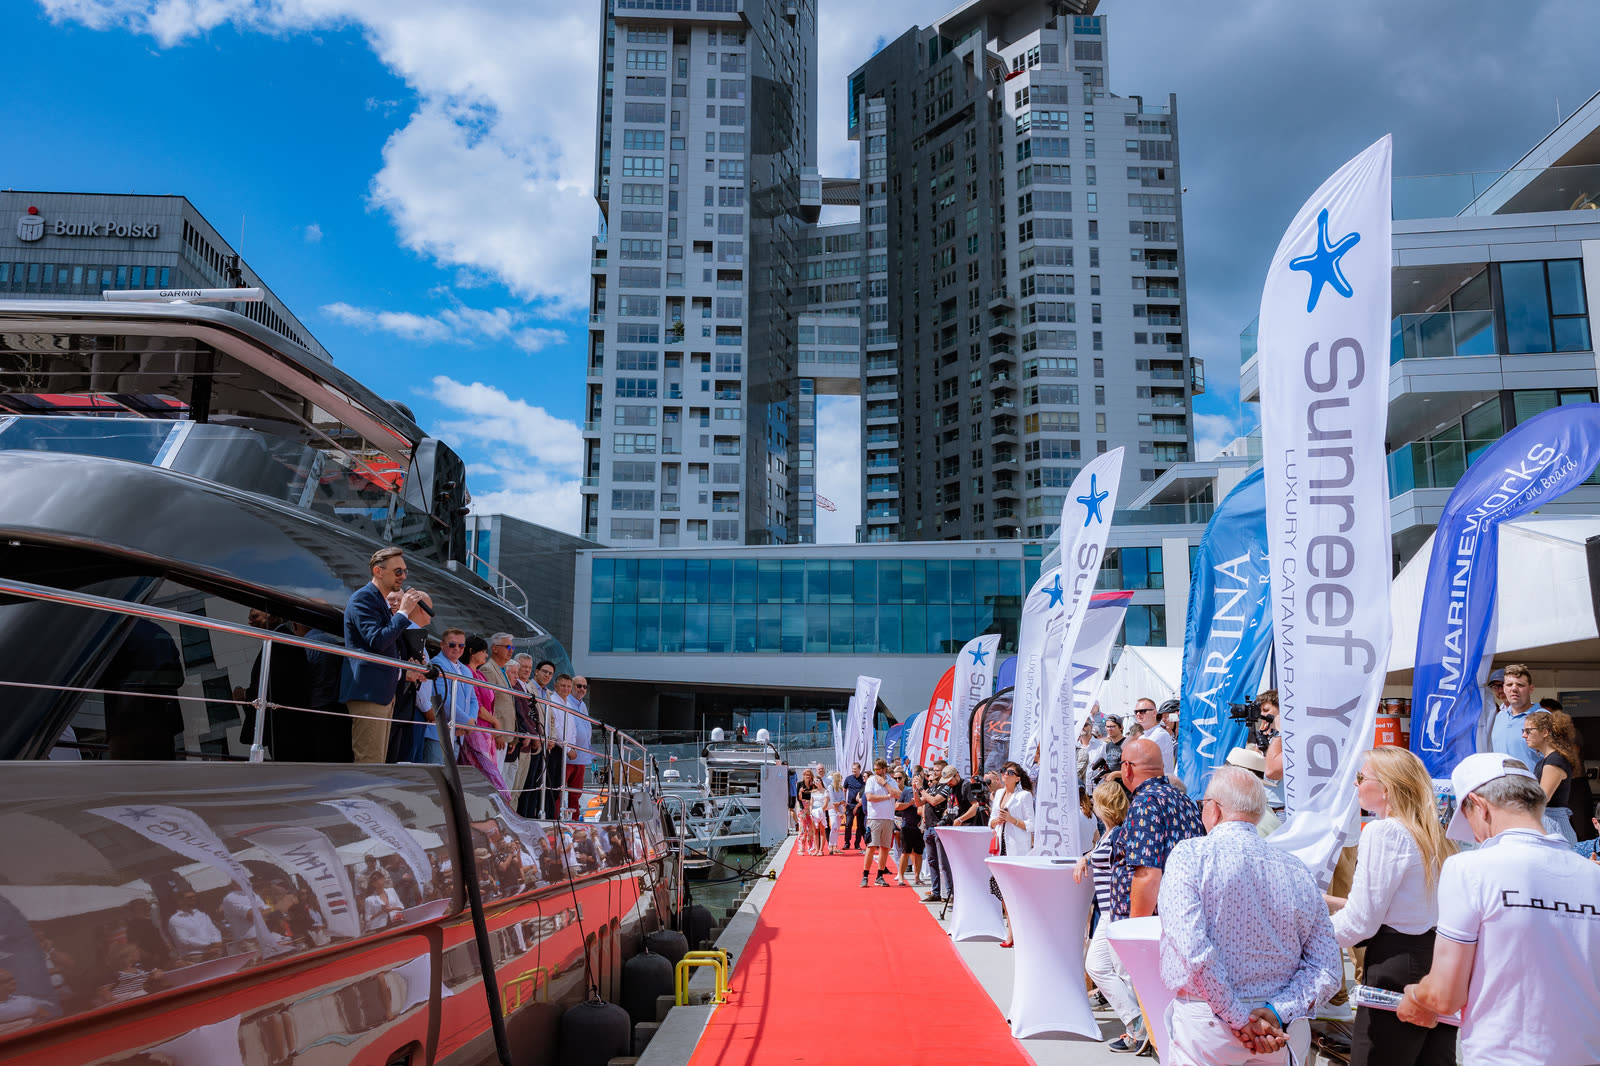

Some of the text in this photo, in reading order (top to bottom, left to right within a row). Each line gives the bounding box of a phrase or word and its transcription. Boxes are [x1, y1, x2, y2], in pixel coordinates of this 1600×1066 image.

[53, 219, 159, 239] Bank Polski
[159, 290, 202, 298] GARMIN
[1284, 449, 1298, 550] LUXURY
[1303, 337, 1377, 674] Sunreef
[1525, 455, 1578, 501] on Board
[1026, 654, 1038, 691] LUXURY
[1191, 549, 1251, 759] MARINA
[1281, 557, 1297, 721] CATAMARAN
